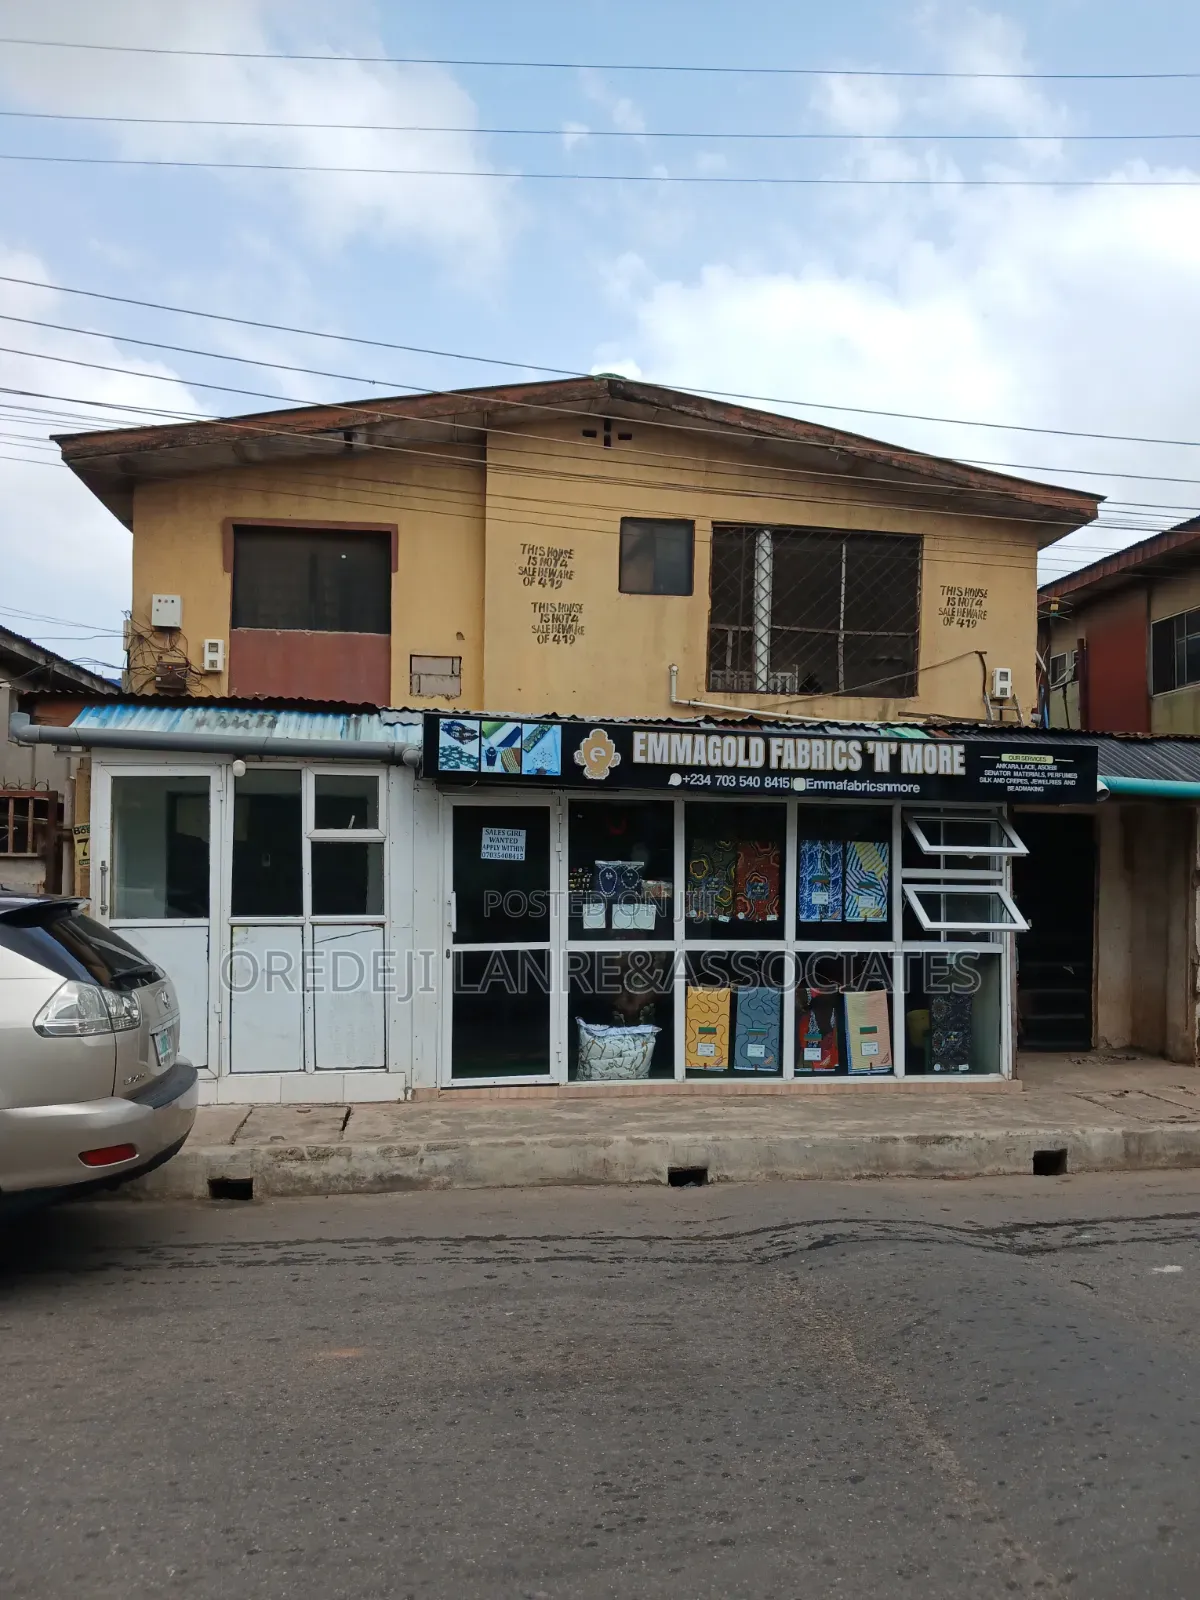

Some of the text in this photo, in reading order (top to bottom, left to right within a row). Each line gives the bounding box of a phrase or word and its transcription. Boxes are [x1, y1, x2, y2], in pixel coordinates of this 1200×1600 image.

[520, 543, 574, 559] THIS HOUSE
[527, 555, 568, 569] IS NOT 4
[518, 566, 575, 580] SALE BEWARE
[523, 576, 563, 590] OF 419
[940, 585, 988, 599] THIS HOUSE
[531, 602, 584, 614] THIS HOUSE
[946, 596, 983, 608] IS NOT 4
[540, 613, 579, 624] IS NOT 4
[938, 607, 988, 620] SALE BEWARE
[942, 616, 977, 628] OF 419
[531, 624, 551, 634] SALE
[537, 634, 576, 645] OF 419
[632, 731, 765, 768] EMMAGOLD
[769, 738, 863, 772] FABRICS
[900, 743, 966, 776] MORE
[1021, 755, 1047, 763] SERVICES
[682, 774, 711, 787] +234
[715, 775, 736, 787] 703
[739, 776, 761, 788] 540
[806, 778, 921, 793] Emmafabricsnmore
[484, 828, 506, 836] SALES
[489, 836, 519, 844] WANTED
